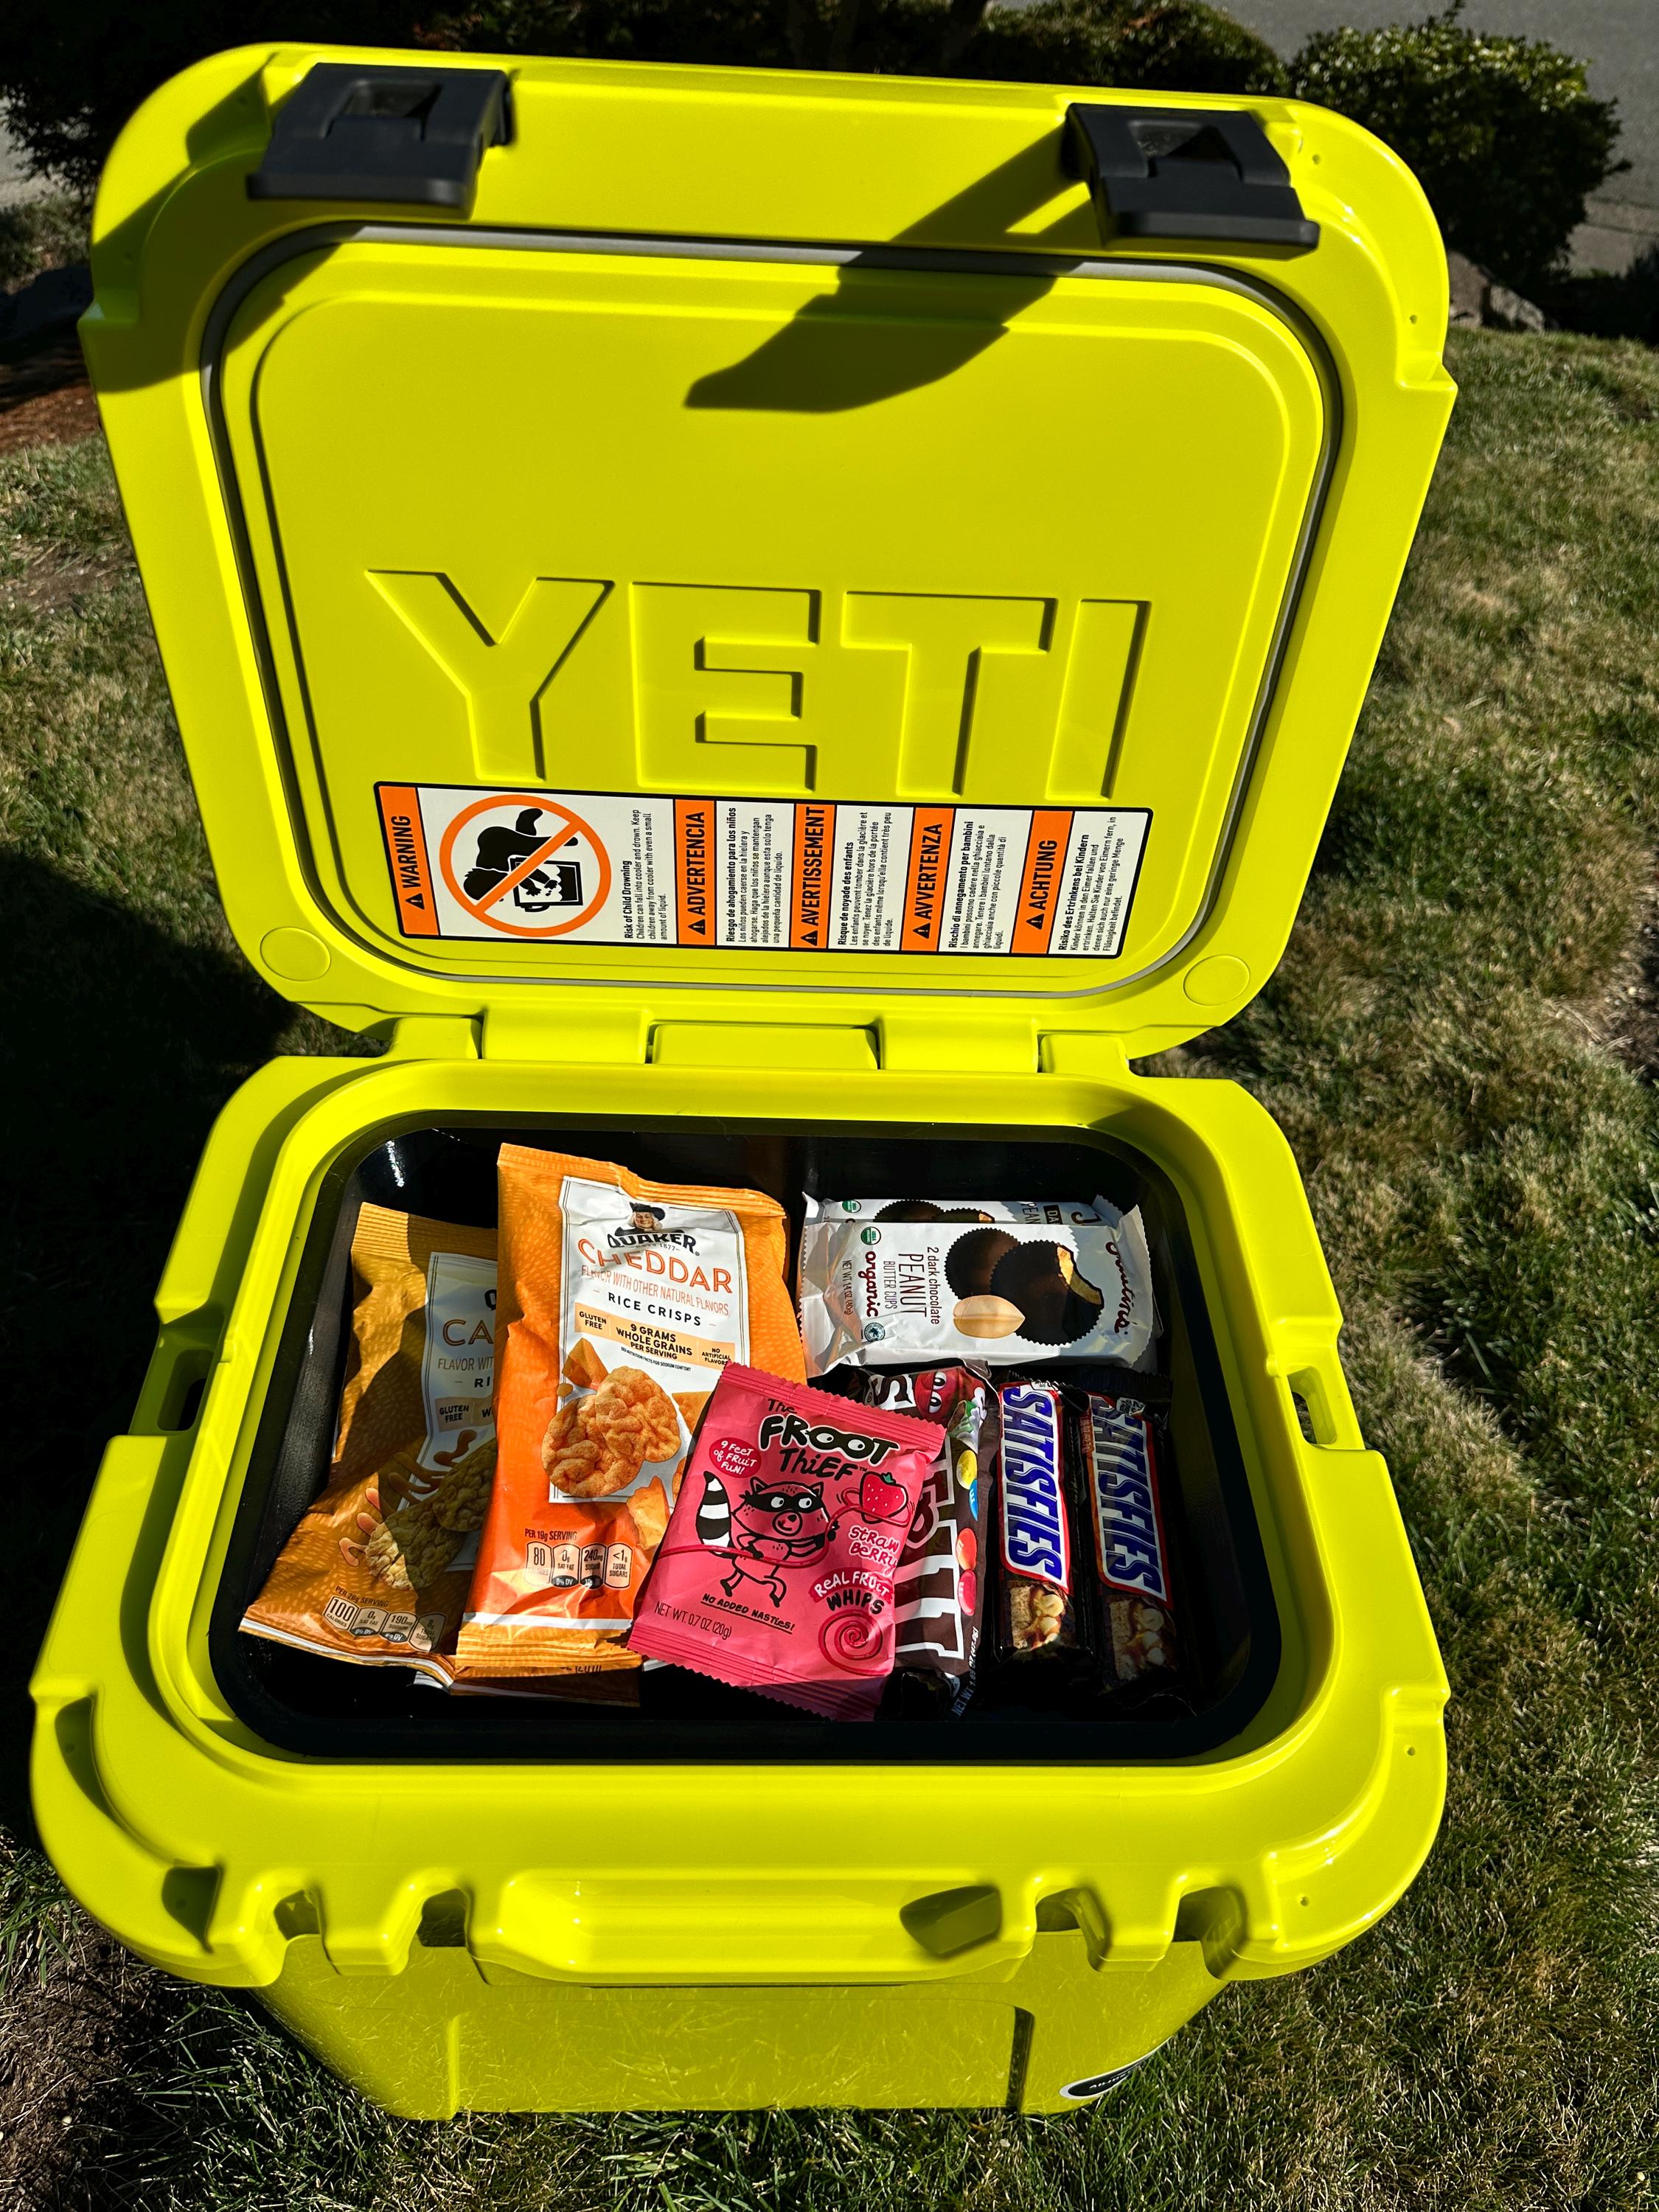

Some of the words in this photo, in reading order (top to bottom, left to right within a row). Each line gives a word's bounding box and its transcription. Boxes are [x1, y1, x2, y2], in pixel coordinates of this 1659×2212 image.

[364, 568, 1151, 801] YETI
[630, 809, 642, 826] Keep
[642, 813, 653, 831] small
[726, 807, 737, 829] niños
[883, 812, 894, 824] peu
[632, 827, 642, 848] drown.
[726, 830, 737, 842] los
[881, 825, 891, 838] très
[961, 821, 975, 852] bambini
[391, 815, 422, 888] WARNING
[645, 836, 654, 852] even
[728, 843, 739, 860] para
[880, 838, 890, 863] contient
[1075, 835, 1088, 863] Kindern
[1091, 844, 1099, 856] und
[632, 849, 642, 860] and
[644, 852, 654, 866] with
[686, 812, 706, 916] ADVERTENCIA
[843, 842, 855, 870] enfants
[961, 852, 972, 865] per
[633, 860, 643, 880] cooler
[801, 807, 826, 926] AVERTISSEMENT
[915, 824, 943, 920] AVVERTENZA
[1073, 865, 1082, 877] bei
[1085, 857, 1096, 874] fallen
[620, 860, 633, 895] Drowning
[645, 866, 655, 886] cooler
[726, 861, 739, 908] ahogamiento
[841, 871, 852, 885] des
[876, 863, 888, 895] lorsqu'elle
[1029, 840, 1058, 911] ACHTUNG
[1082, 874, 1092, 892] Eimer
[634, 880, 644, 893] into
[646, 886, 655, 900] from
[955, 866, 969, 915] annegamento
[1065, 877, 1080, 915] Ertrinkens
[622, 896, 633, 914] Child
[634, 893, 644, 903] fall
[657, 894, 669, 911] liquid.
[841, 886, 853, 911] noyade
[874, 896, 885, 914] même
[1079, 893, 1089, 904] den
[636, 904, 644, 915] can
[648, 900, 658, 916] away
[726, 908, 736, 918] de
[839, 912, 849, 922] de
[623, 915, 633, 923] of
[636, 915, 646, 939] Children
[647, 917, 657, 940] children
[872, 914, 883, 936] enfants
[1063, 916, 1073, 929] des
[1074, 911, 1085, 932] können
[624, 923, 634, 939] Risk
[658, 919, 668, 940] amount
[726, 919, 739, 942] Riesgo
[838, 922, 851, 945] Risque
[949, 923, 961, 948] Rischio
[872, 936, 881, 946] des
[1059, 930, 1070, 950] Risiko
[1070, 932, 1081, 950] Kinder
[1020, 1203, 1041, 1225] PEAN
[607, 1232, 697, 1254] QUAKER
[578, 1238, 733, 1294] CHEDDAR
[842, 1259, 852, 1273] NET
[883, 1261, 897, 1289] BUTTER
[928, 1255, 939, 1276] dark
[842, 1273, 852, 1282] WT
[858, 1251, 880, 1318] organic
[898, 1253, 927, 1318] PEANUT
[581, 1265, 612, 1282] FLAVOR
[613, 1271, 632, 1290] WITH
[633, 1279, 658, 1297] OTHER
[660, 1285, 695, 1307] NATURAL
[696, 1297, 729, 1317] FLAVORS
[884, 1291, 897, 1310] CUPS
[608, 1292, 641, 1311] RICE
[647, 1304, 701, 1326] CRISPS
[928, 1279, 942, 1325] chocolate
[579, 1311, 607, 1325] GLUTEN
[585, 1319, 603, 1330] FREE
[616, 1326, 651, 1346] WHOLE
[653, 1338, 693, 1356] GRAINS
[630, 1324, 637, 1332] 9
[639, 1326, 676, 1343] GRAMS
[630, 1342, 644, 1354] PER
[645, 1344, 678, 1360] SERVING
[702, 1352, 731, 1360] ARTIFICIAL
[437, 1357, 474, 1371] FLAVOR
[478, 1356, 495, 1371] WIT
[474, 1376, 491, 1388] RI
[439, 1405, 470, 1416] GLUTEN
[767, 1398, 798, 1414] The
[445, 1412, 463, 1422] FREE
[720, 1440, 728, 1450] 9
[759, 1413, 900, 1467] FROOT
[713, 1448, 726, 1463] of
[1002, 1385, 1062, 1582] SATISFIES
[524, 1528, 536, 1538] PER
[537, 1531, 548, 1543] 19g
[549, 1531, 577, 1541] SERVING
[533, 1547, 546, 1566] 80
[609, 1570, 628, 1578] SUGARS
[613, 1562, 627, 1571] TOTAL
[565, 1578, 574, 1586] DV
[335, 1585, 348, 1598] PER
[360, 1598, 390, 1607] SERVING
[702, 1593, 717, 1604] NO
[717, 1599, 749, 1613] ADDED
[826, 1588, 885, 1615] WHIPS
[330, 1599, 355, 1622] 100
[326, 1613, 348, 1628] CALORIES
[655, 1601, 672, 1618] NET
[672, 1607, 688, 1624] WT.
[688, 1613, 700, 1627] 0.7
[700, 1617, 713, 1632] OZ
[712, 1621, 733, 1641] (20g)
[950, 1697, 967, 1716] NET
